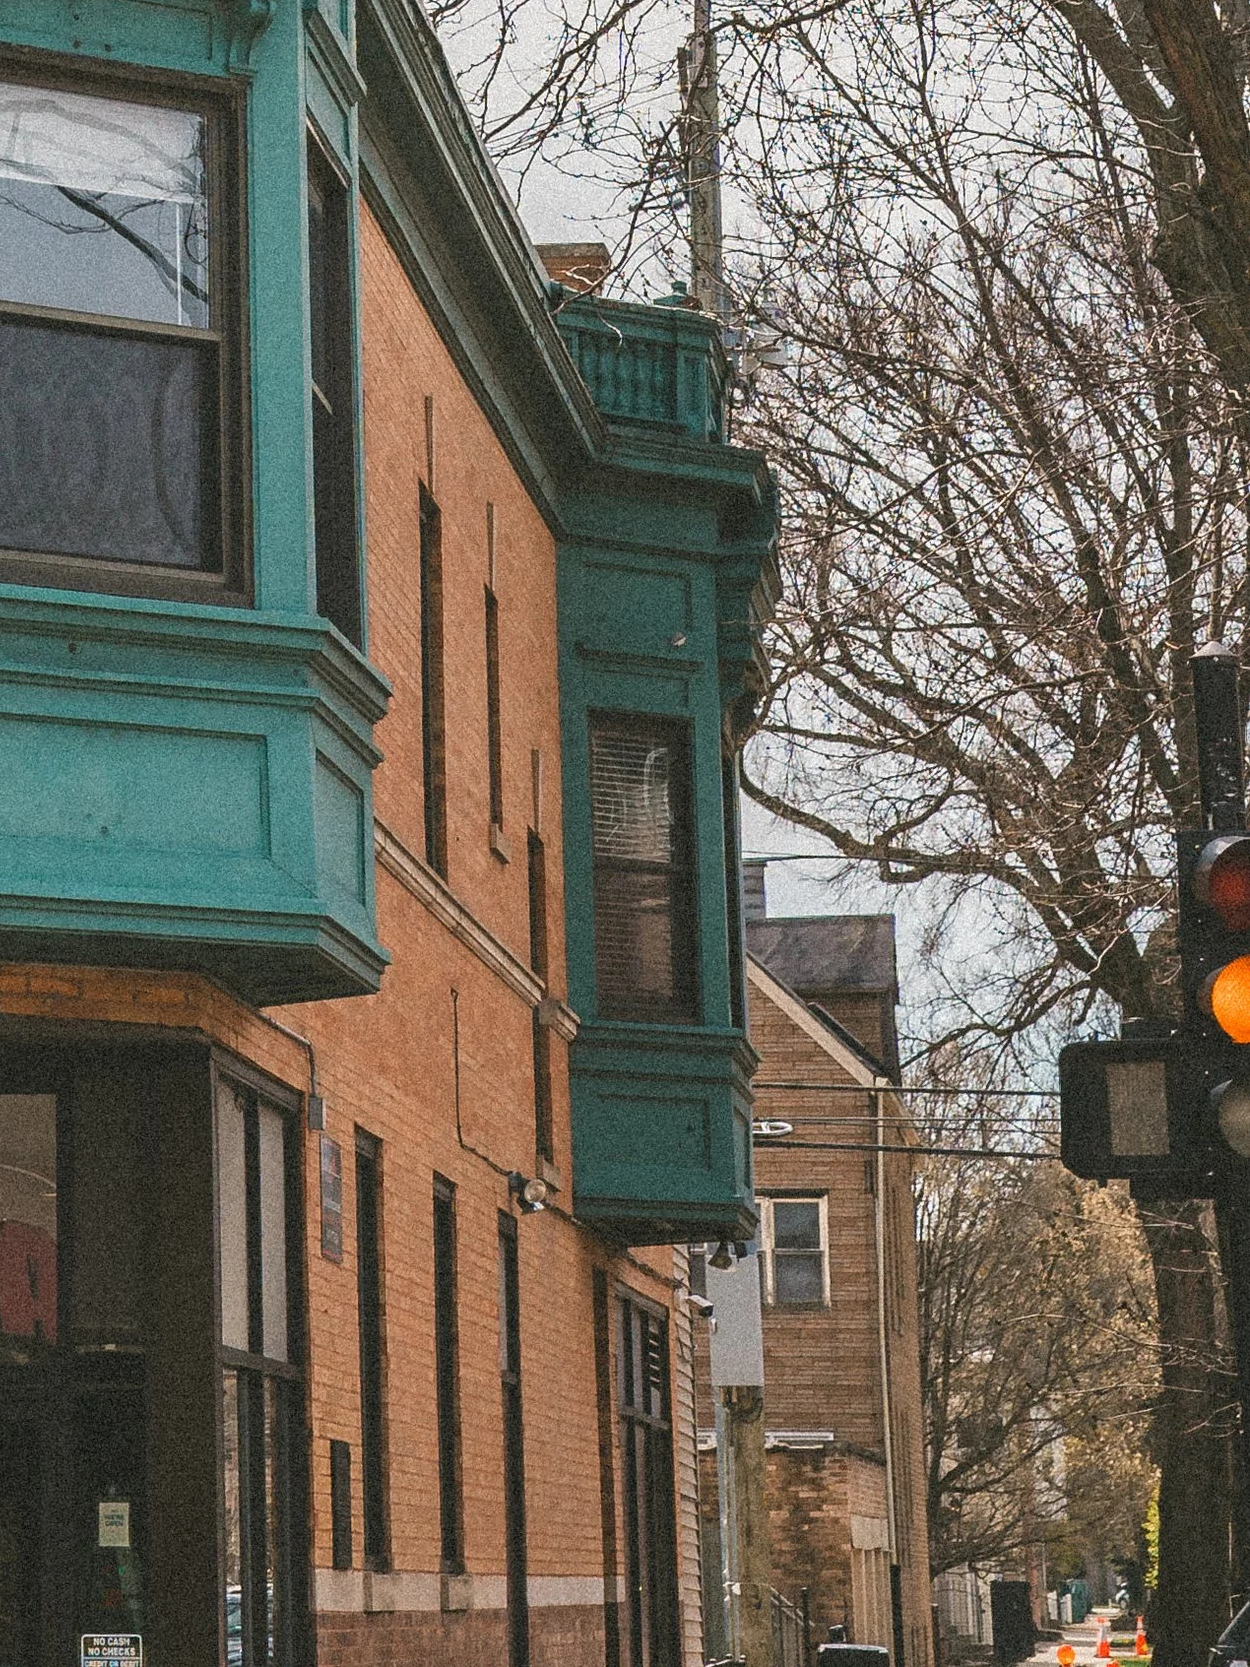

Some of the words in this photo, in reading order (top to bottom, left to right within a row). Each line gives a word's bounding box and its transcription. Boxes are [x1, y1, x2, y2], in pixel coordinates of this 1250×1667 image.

[93, 1637, 106, 1646] NO
[107, 1637, 130, 1646] CASH
[87, 1647, 100, 1656] NO
[101, 1647, 136, 1656] CHECKS
